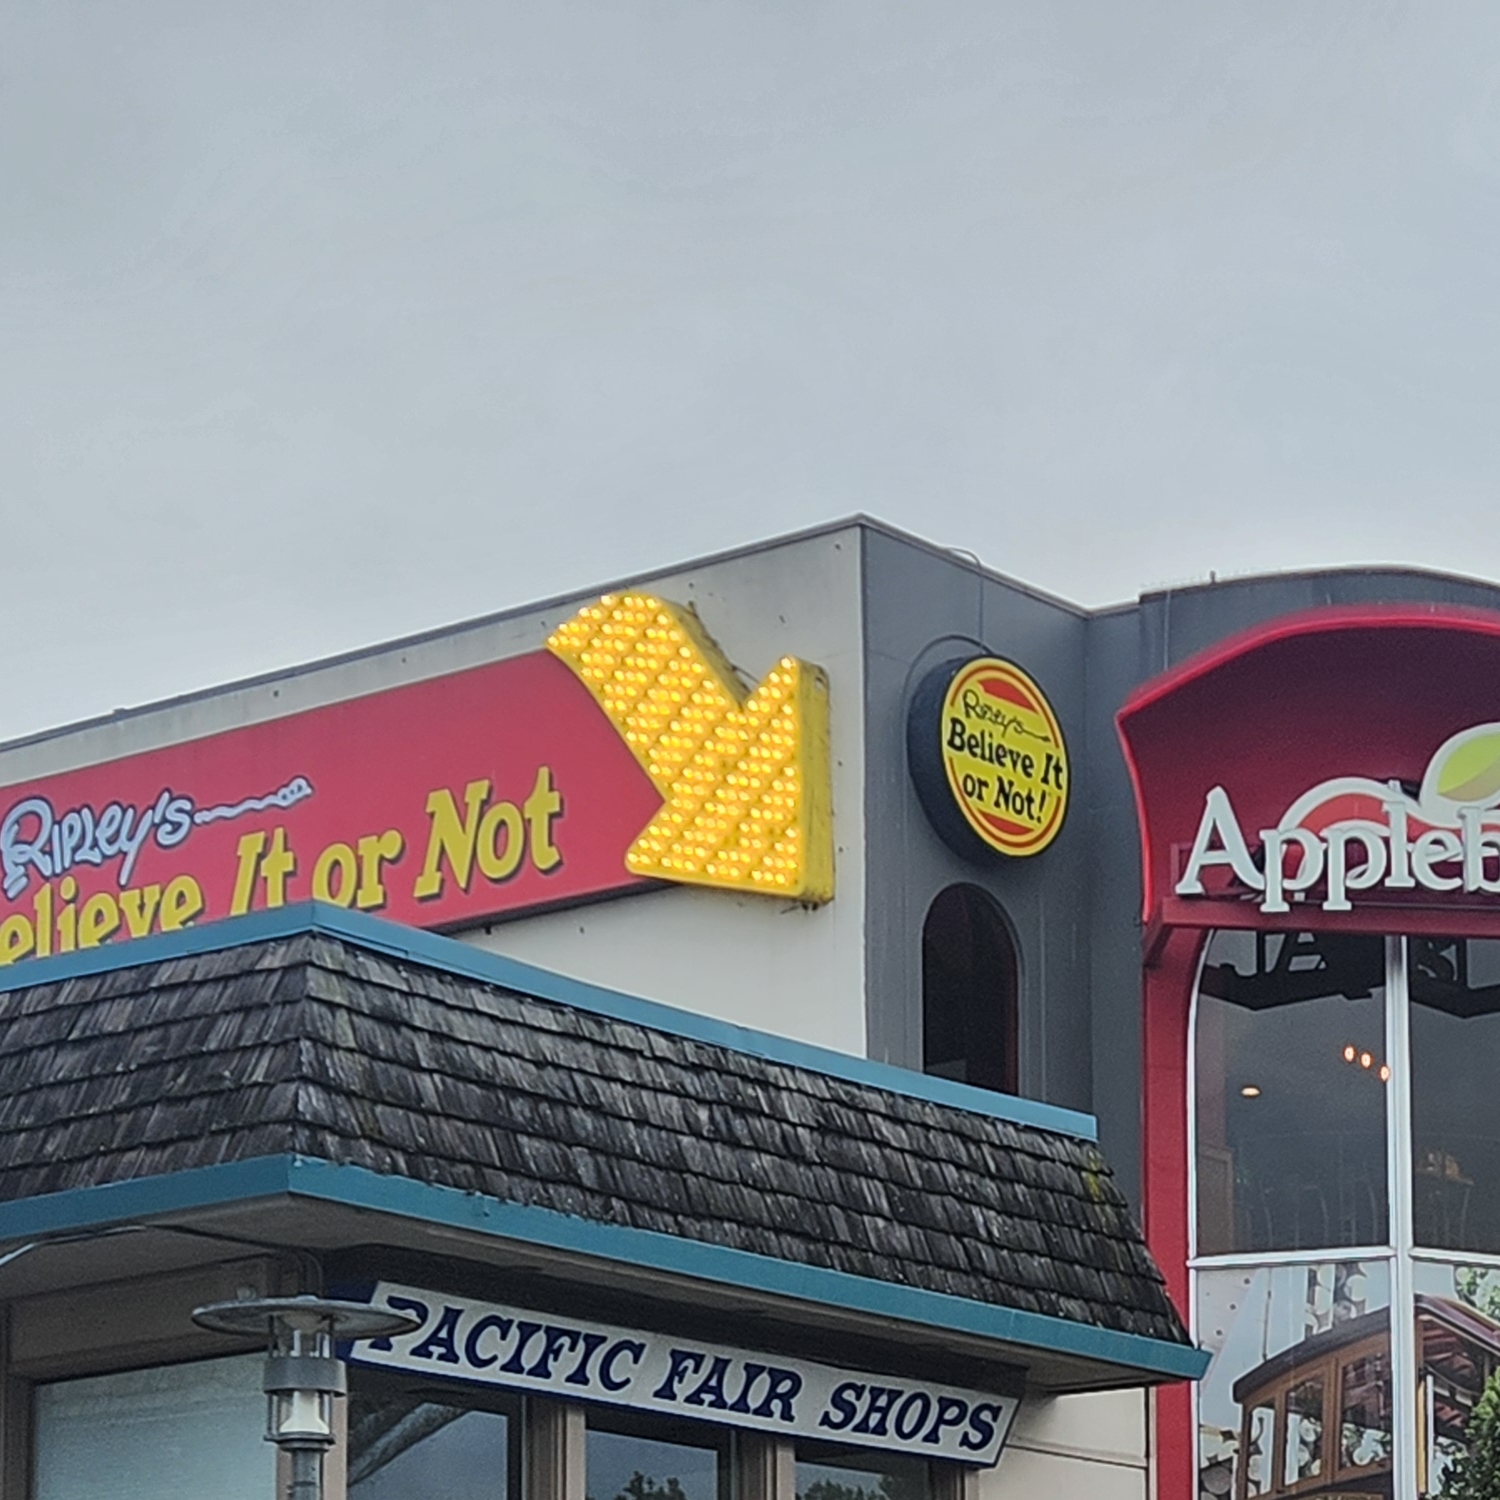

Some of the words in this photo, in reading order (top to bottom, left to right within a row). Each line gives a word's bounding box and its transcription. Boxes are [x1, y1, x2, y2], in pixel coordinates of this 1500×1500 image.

[947, 717, 1034, 779] Believe
[1041, 753, 1063, 791] It
[963, 774, 989, 802] or
[994, 775, 1047, 824] Not!
[230, 827, 295, 916] It
[312, 829, 402, 908] or
[413, 766, 562, 898] Not
[369, 1295, 647, 1392] PACIFIC
[652, 1348, 803, 1423] FAIR
[819, 1381, 1002, 1451] SHOPS
